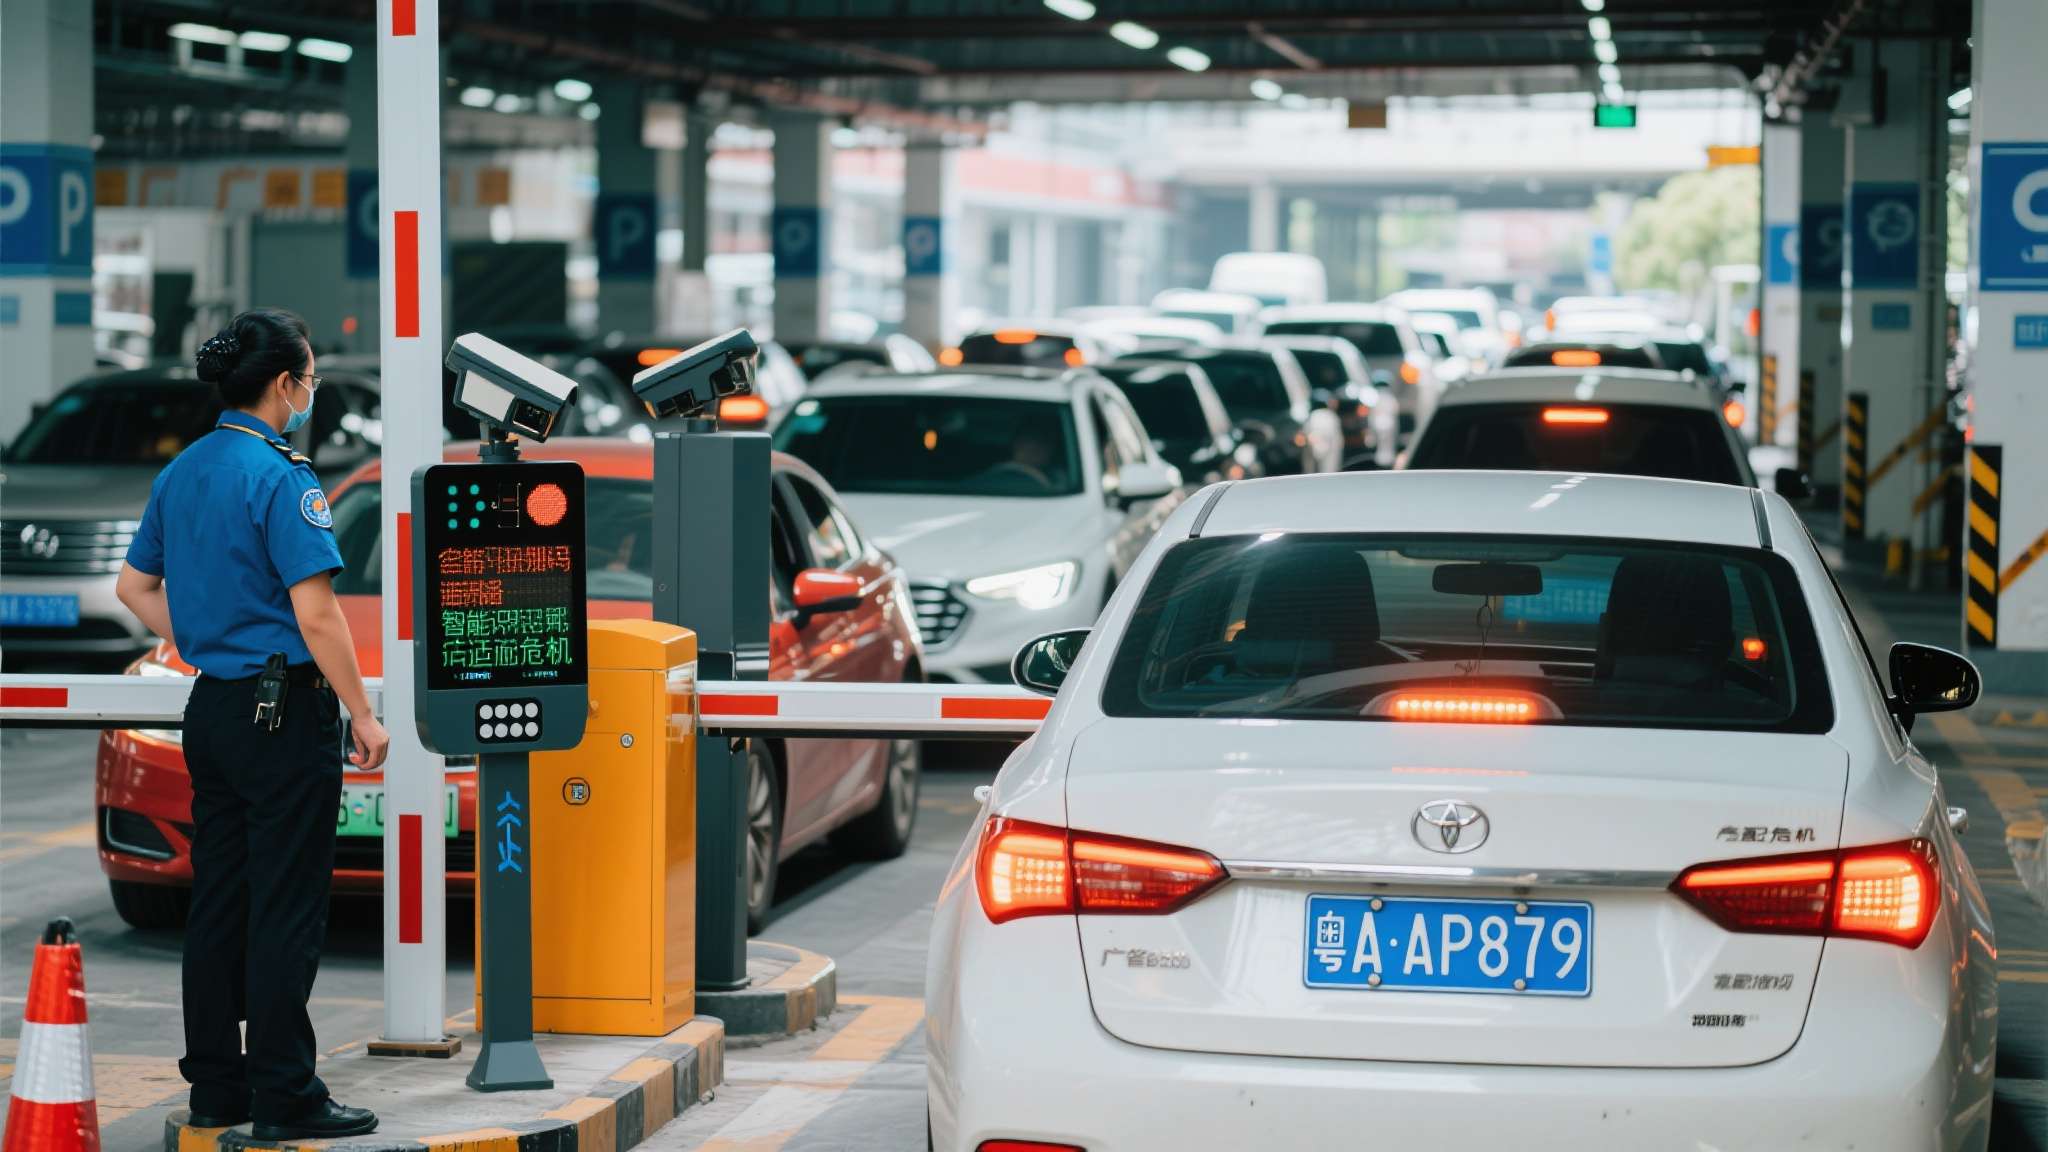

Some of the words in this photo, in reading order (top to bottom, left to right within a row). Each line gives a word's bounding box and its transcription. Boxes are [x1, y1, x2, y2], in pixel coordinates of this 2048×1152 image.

[59, 170, 88, 257] P
[608, 205, 646, 263] P
[1313, 910, 1583, 980] 粤A·AP879
